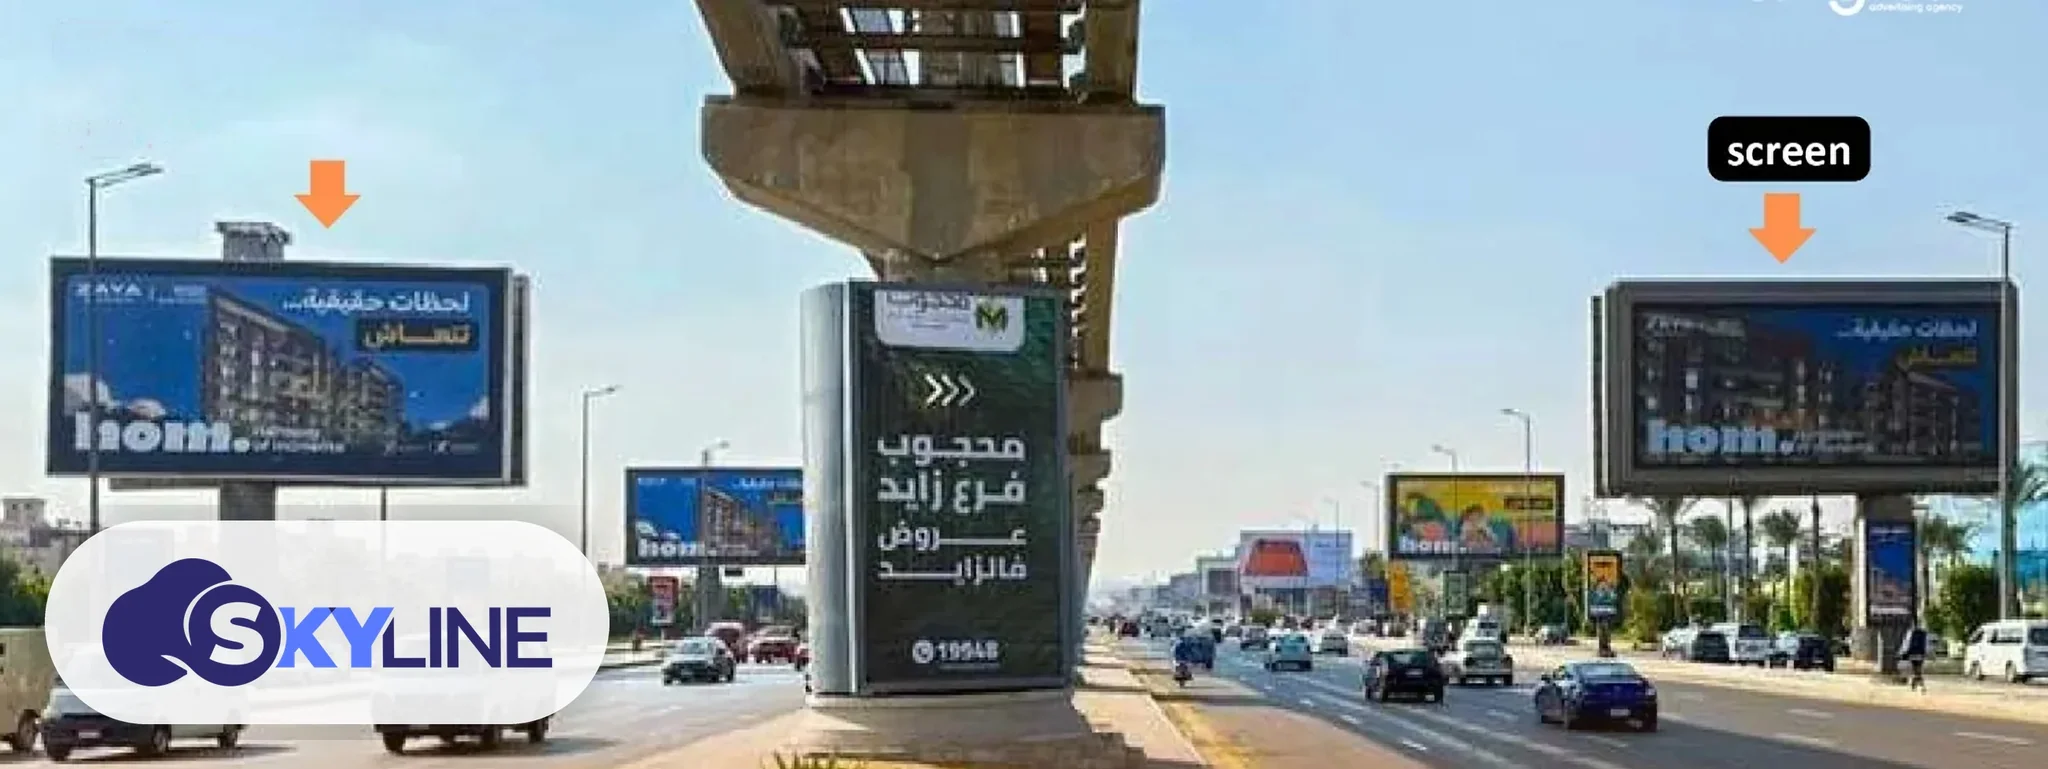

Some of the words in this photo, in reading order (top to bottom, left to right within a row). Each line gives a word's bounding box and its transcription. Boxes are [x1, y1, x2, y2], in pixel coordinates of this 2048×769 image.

[388, 290, 471, 312] لحظات
[877, 434, 1024, 467] محجوب
[877, 468, 942, 511] زايد
[953, 470, 1024, 514] فرع
[877, 518, 1027, 550] عروض
[878, 553, 1027, 586] فالزايد
